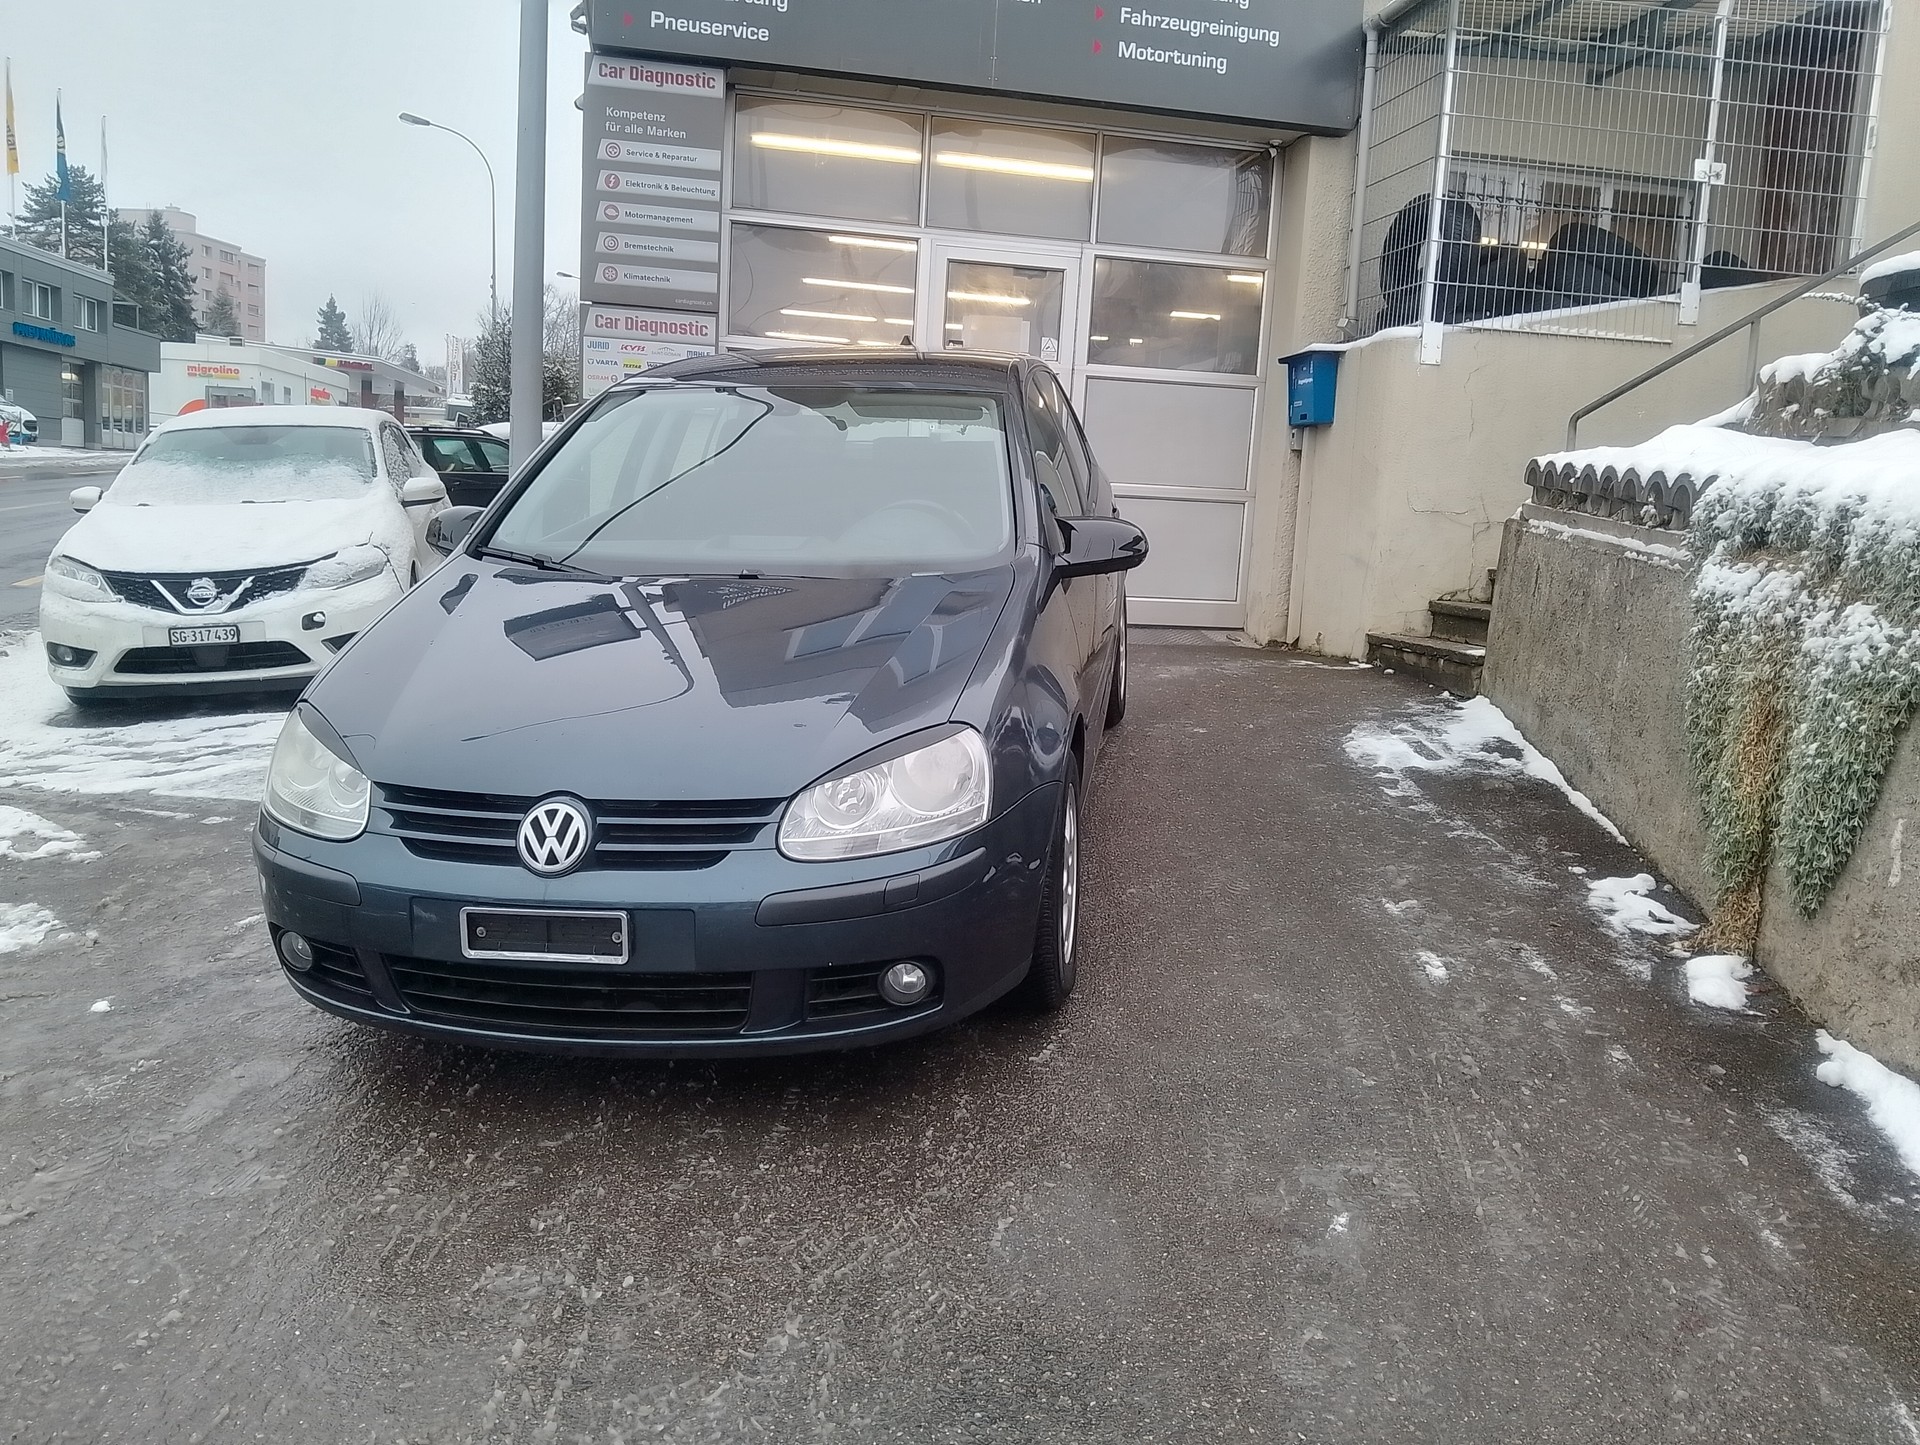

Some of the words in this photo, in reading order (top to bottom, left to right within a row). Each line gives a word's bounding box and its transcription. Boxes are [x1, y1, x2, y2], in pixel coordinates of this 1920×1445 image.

[650, 10, 770, 41] Pneuservice
[1120, 6, 1280, 47] Fahrzeugreinigung
[1117, 40, 1228, 74] Motortuning
[598, 62, 625, 79] Car
[629, 65, 716, 89] Diagnostic
[605, 106, 666, 122] Kompetenz
[605, 121, 621, 132] für
[624, 123, 643, 134] alle
[647, 125, 687, 139] Marken
[626, 148, 654, 158] Service
[661, 152, 698, 162] Reparatur
[625, 180, 662, 190] Elektronik
[671, 184, 716, 196] Beleuchtung
[624, 210, 694, 224] Motormanagement
[624, 241, 674, 253] Bremstechnik
[623, 272, 671, 283] Klimatechnik
[594, 314, 621, 330] Car
[624, 315, 709, 337] Diagnostic
[587, 340, 610, 350] JURID
[187, 364, 240, 375] migrolino
[595, 359, 618, 367] VARTA
[587, 374, 610, 382] OSRAM
